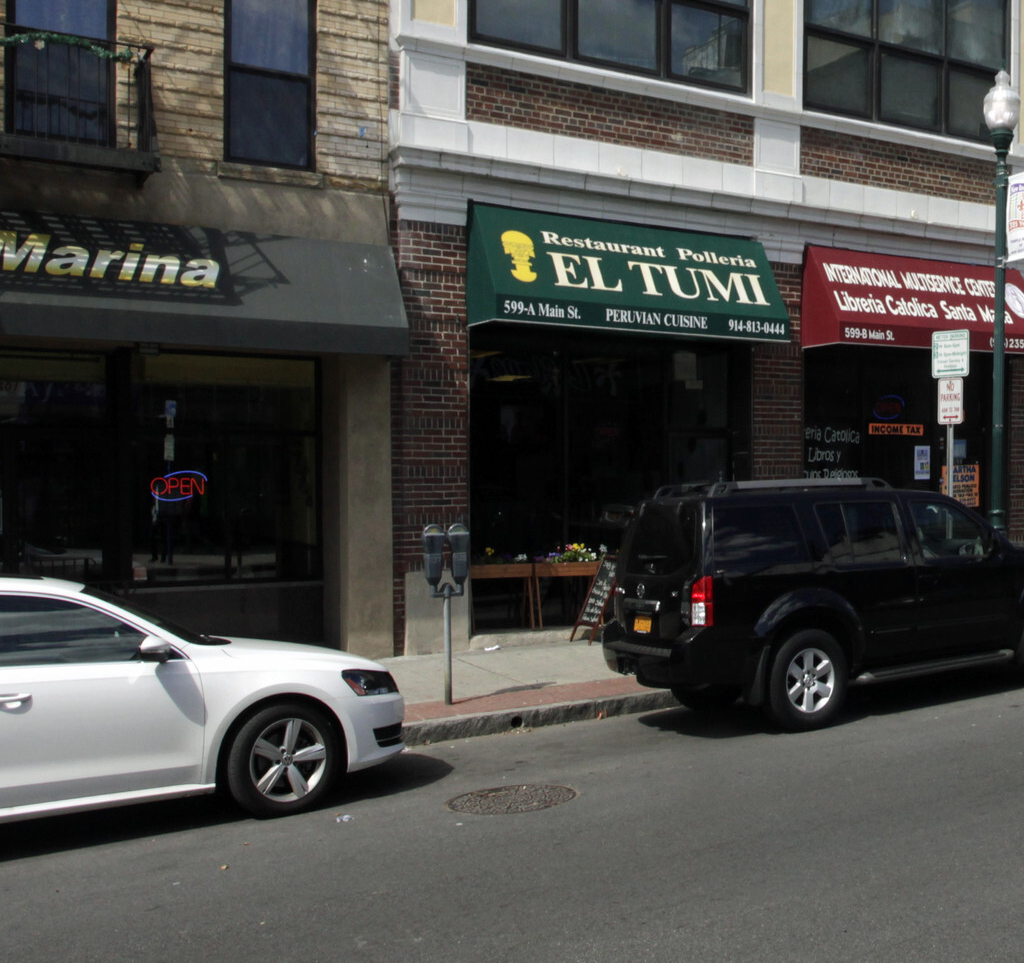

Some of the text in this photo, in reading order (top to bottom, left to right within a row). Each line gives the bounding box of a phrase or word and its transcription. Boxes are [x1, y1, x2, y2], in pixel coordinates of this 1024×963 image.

[540, 230, 757, 269] Restaurant Polleria
[0, 231, 220, 288] Marina
[546, 251, 771, 307] EL TUMI
[822, 262, 903, 289] INTERNATIONAL
[900, 271, 967, 296] MULTISERVICE
[503, 299, 581, 320] 599-A Main St.
[833, 290, 1013, 325] Libreria Catolica Santa Maa
[605, 308, 708, 330] PERUVIAN CUISINE
[728, 318, 785, 335] 914-813-0444
[844, 327, 895, 341] 599-B Main St.
[947, 382, 954, 392] NO
[940, 393, 960, 402] PARKING
[824, 426, 860, 444] Catolica
[871, 425, 921, 435] INCOME TAX
[808, 447, 841, 464] Libros y
[150, 477, 205, 495] OPEN
